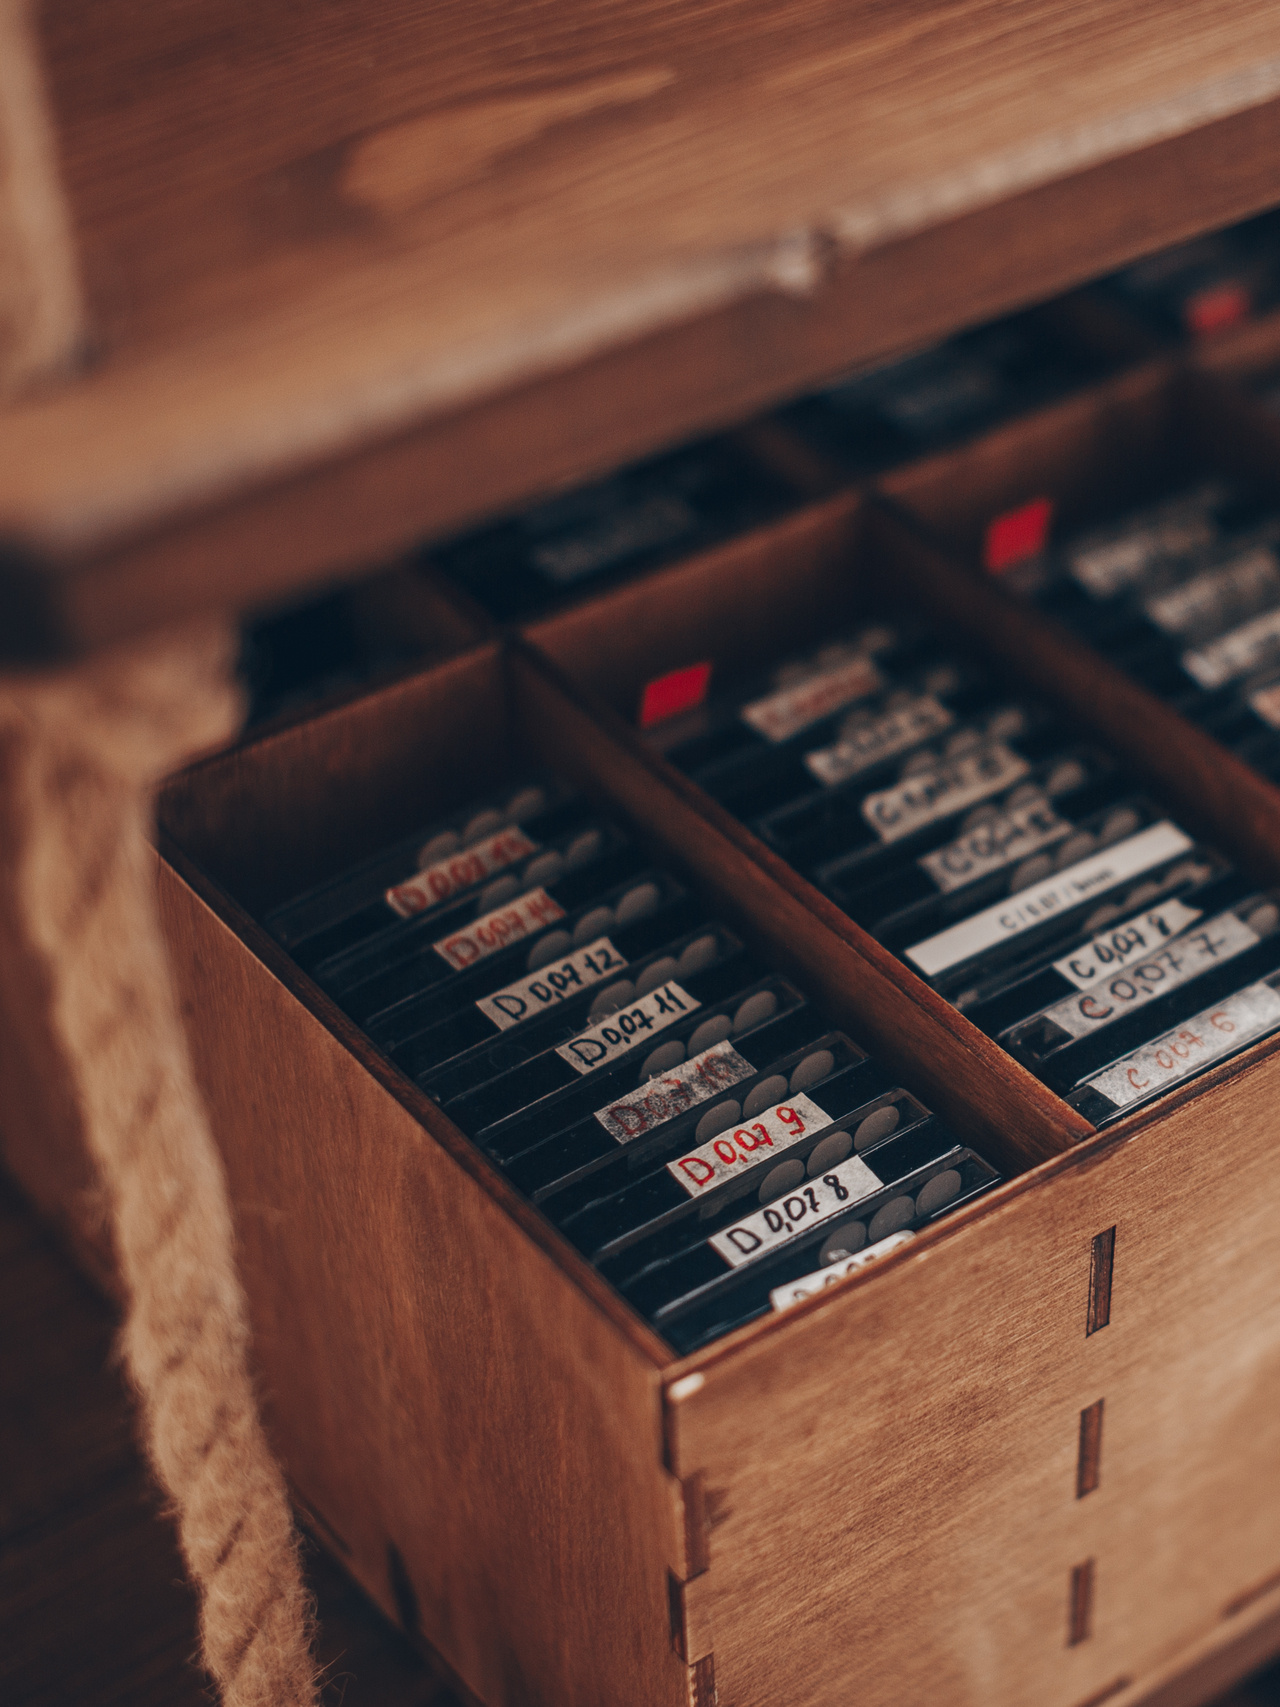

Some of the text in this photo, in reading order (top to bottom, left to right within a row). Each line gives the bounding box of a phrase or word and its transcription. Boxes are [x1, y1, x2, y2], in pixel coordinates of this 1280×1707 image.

[445, 936, 479, 967] D
[491, 949, 623, 1021] D 0,07 12
[1069, 960, 1096, 978] C
[1093, 926, 1148, 965] 0,07
[1079, 933, 1226, 1019] C 0,07 7
[568, 985, 688, 1067] D 0,07 11
[1127, 1068, 1150, 1090] C
[1210, 1012, 1236, 1033] 6
[608, 1105, 647, 1136] D
[678, 1106, 805, 1187] D 0,07 9
[726, 1174, 849, 1254] D 0,07 8
